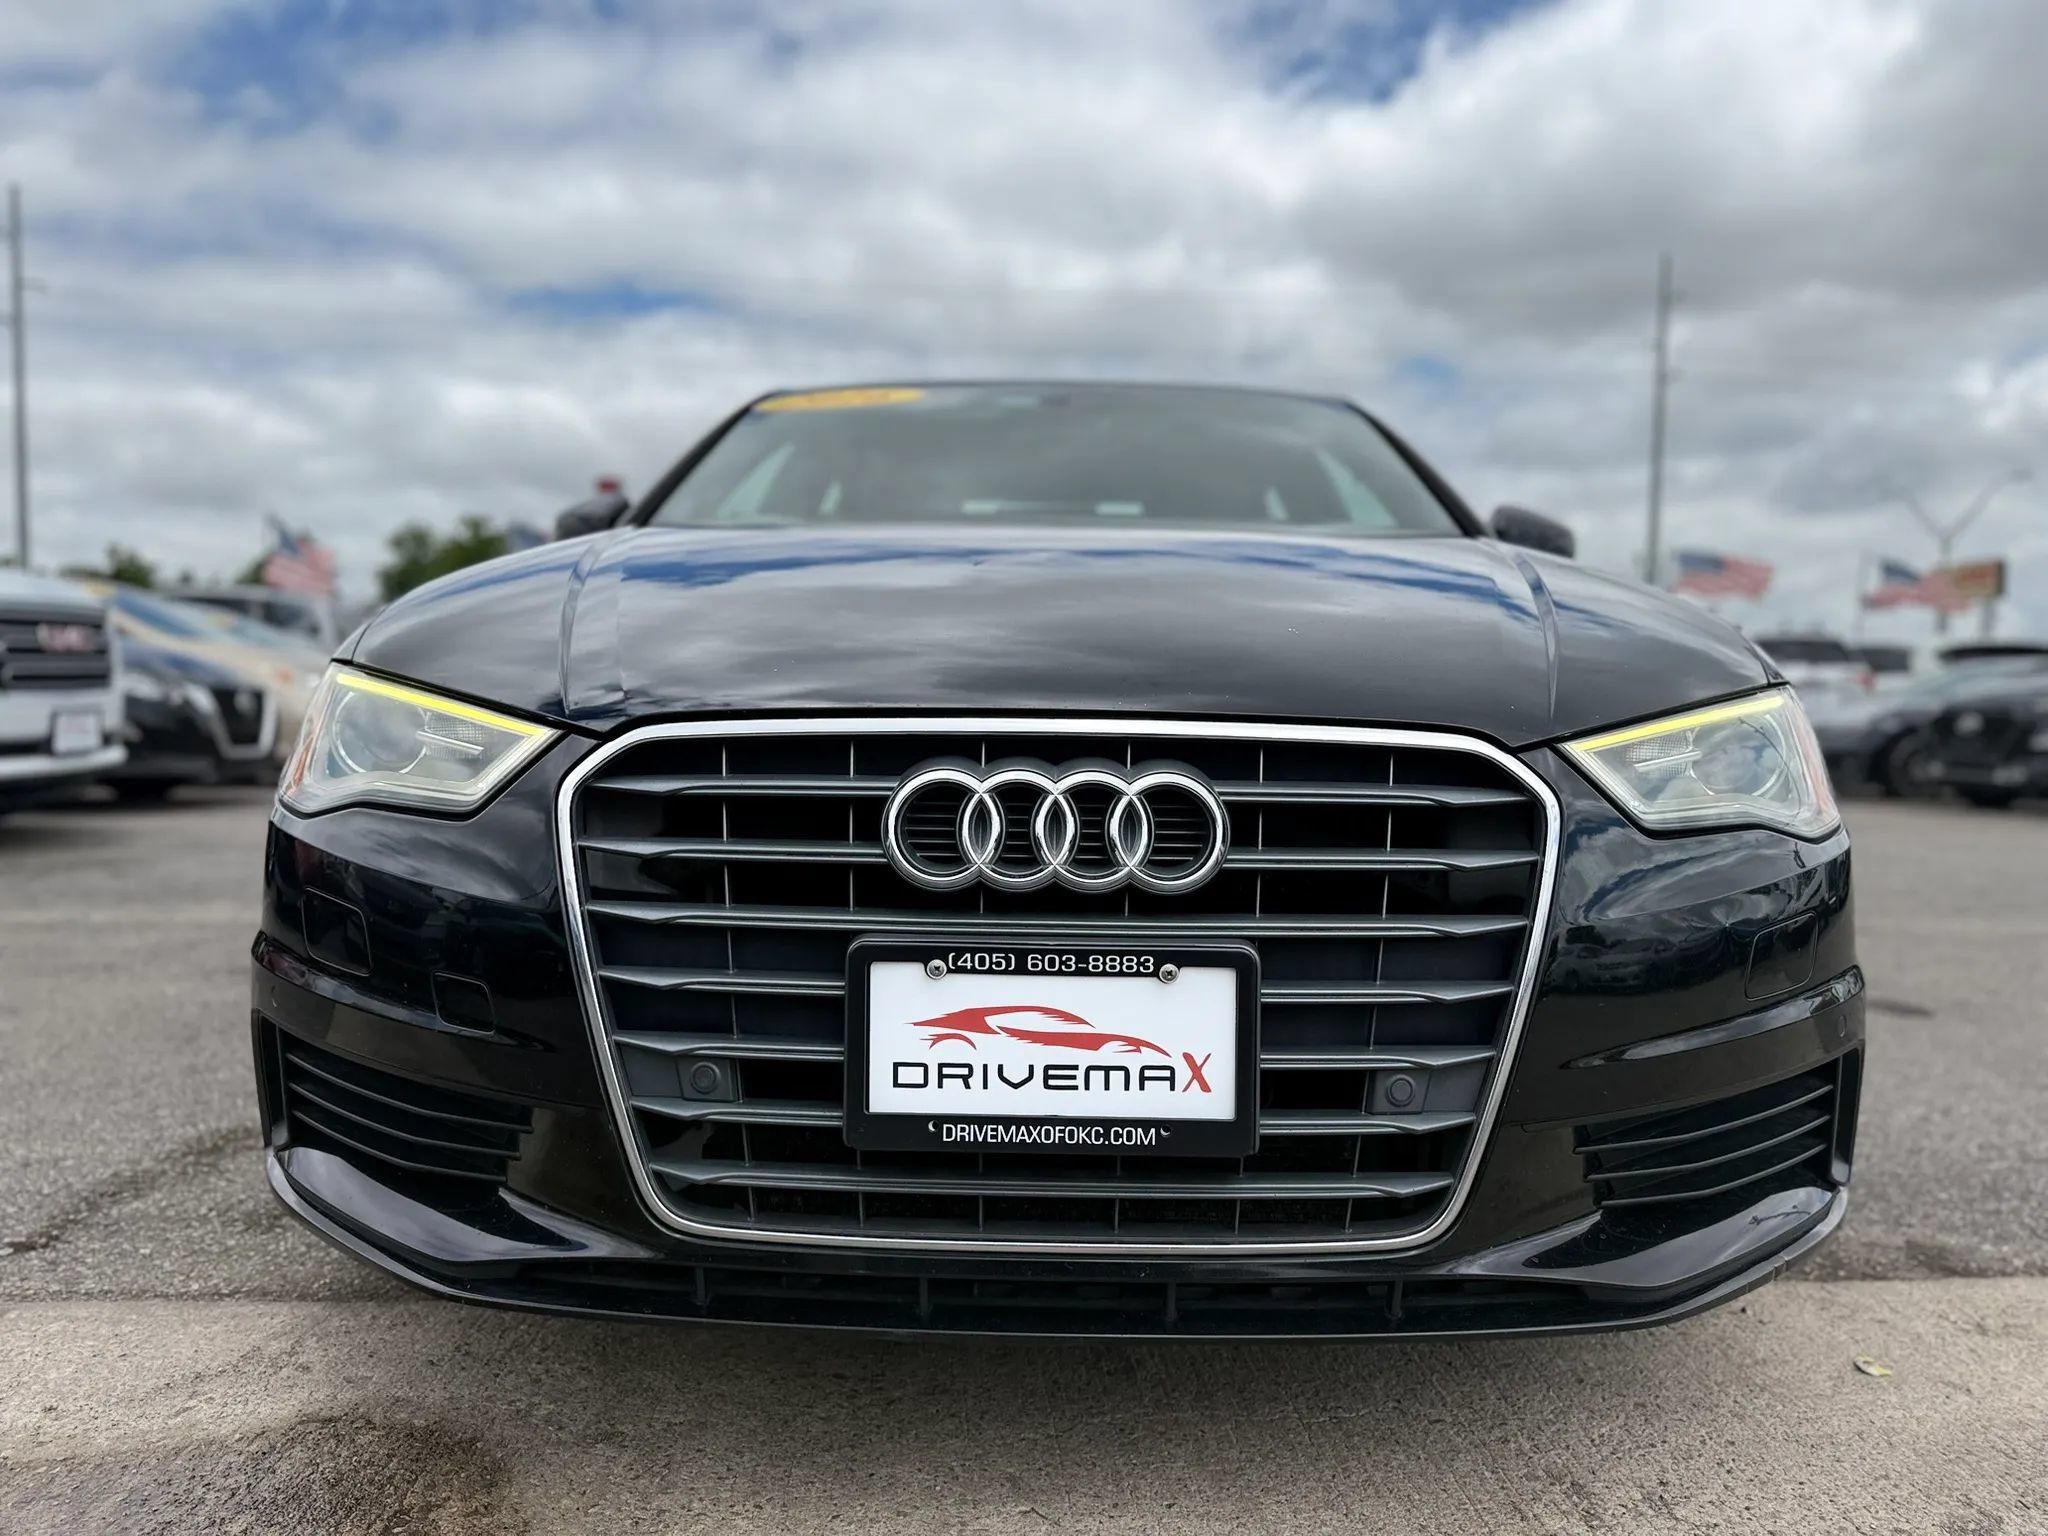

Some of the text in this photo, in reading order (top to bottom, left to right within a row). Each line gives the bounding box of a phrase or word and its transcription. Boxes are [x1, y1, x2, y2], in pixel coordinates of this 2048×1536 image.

[948, 952, 1155, 974] (405) 603-8883
[892, 1051, 1213, 1094] DRIVEMAX
[942, 1123, 1156, 1146] DRIVEMAXOFOKC.COM
